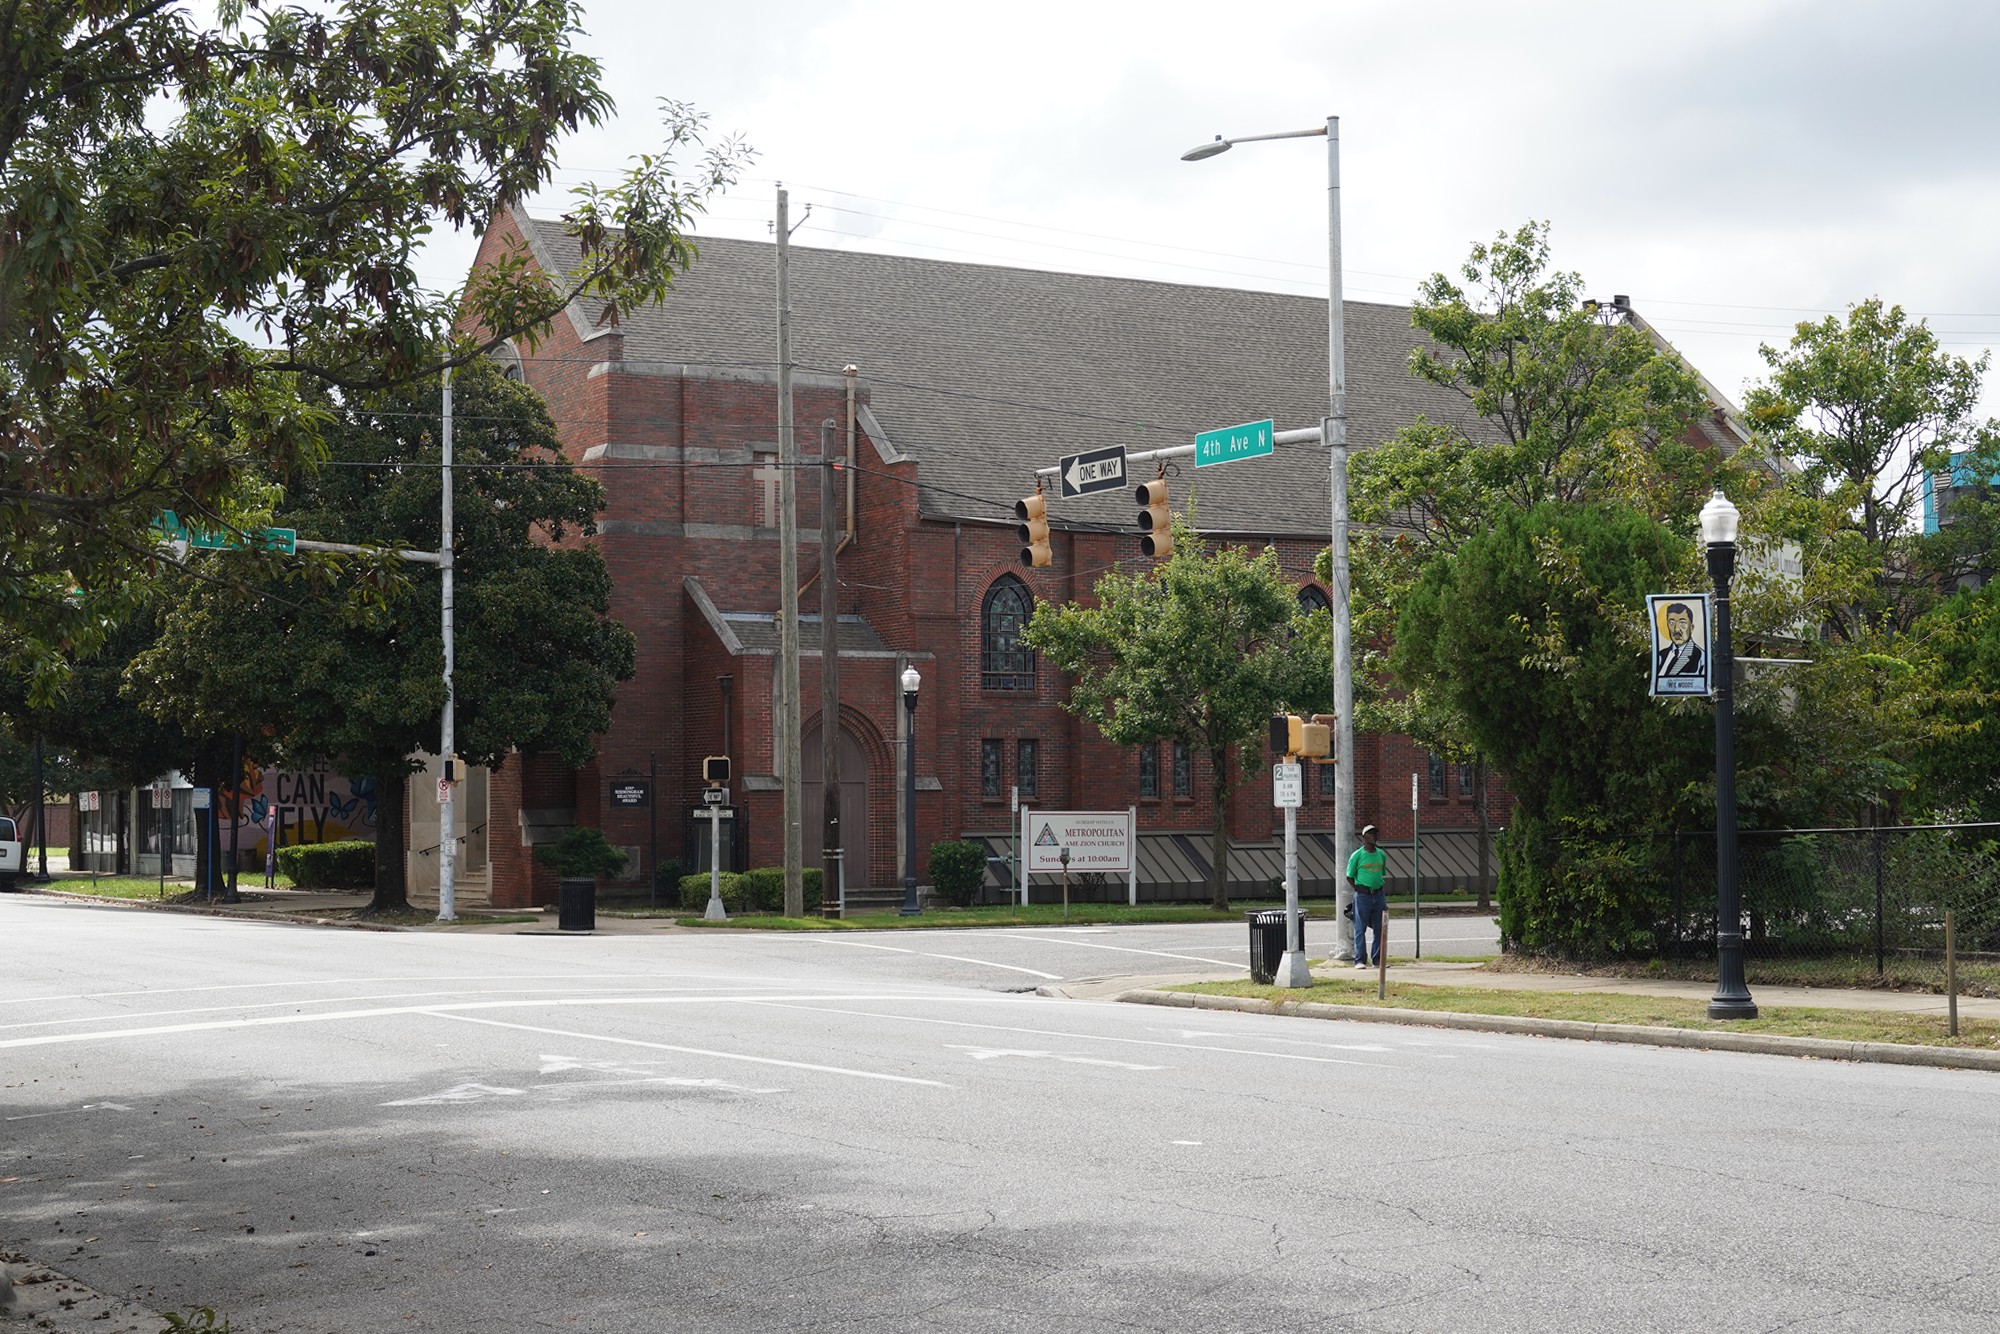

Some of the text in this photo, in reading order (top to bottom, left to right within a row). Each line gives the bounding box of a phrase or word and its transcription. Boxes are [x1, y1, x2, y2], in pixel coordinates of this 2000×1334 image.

[1203, 430, 1265, 457] 4th Ave N
[1079, 459, 1118, 481] ONE WAY
[1276, 767, 1282, 778] 2
[277, 773, 324, 804] CAN
[279, 807, 329, 845] FLY
[1065, 828, 1125, 837] METROPOLITAN
[1039, 855, 1076, 863] Sunds
[1087, 855, 1120, 863] 10:00am
